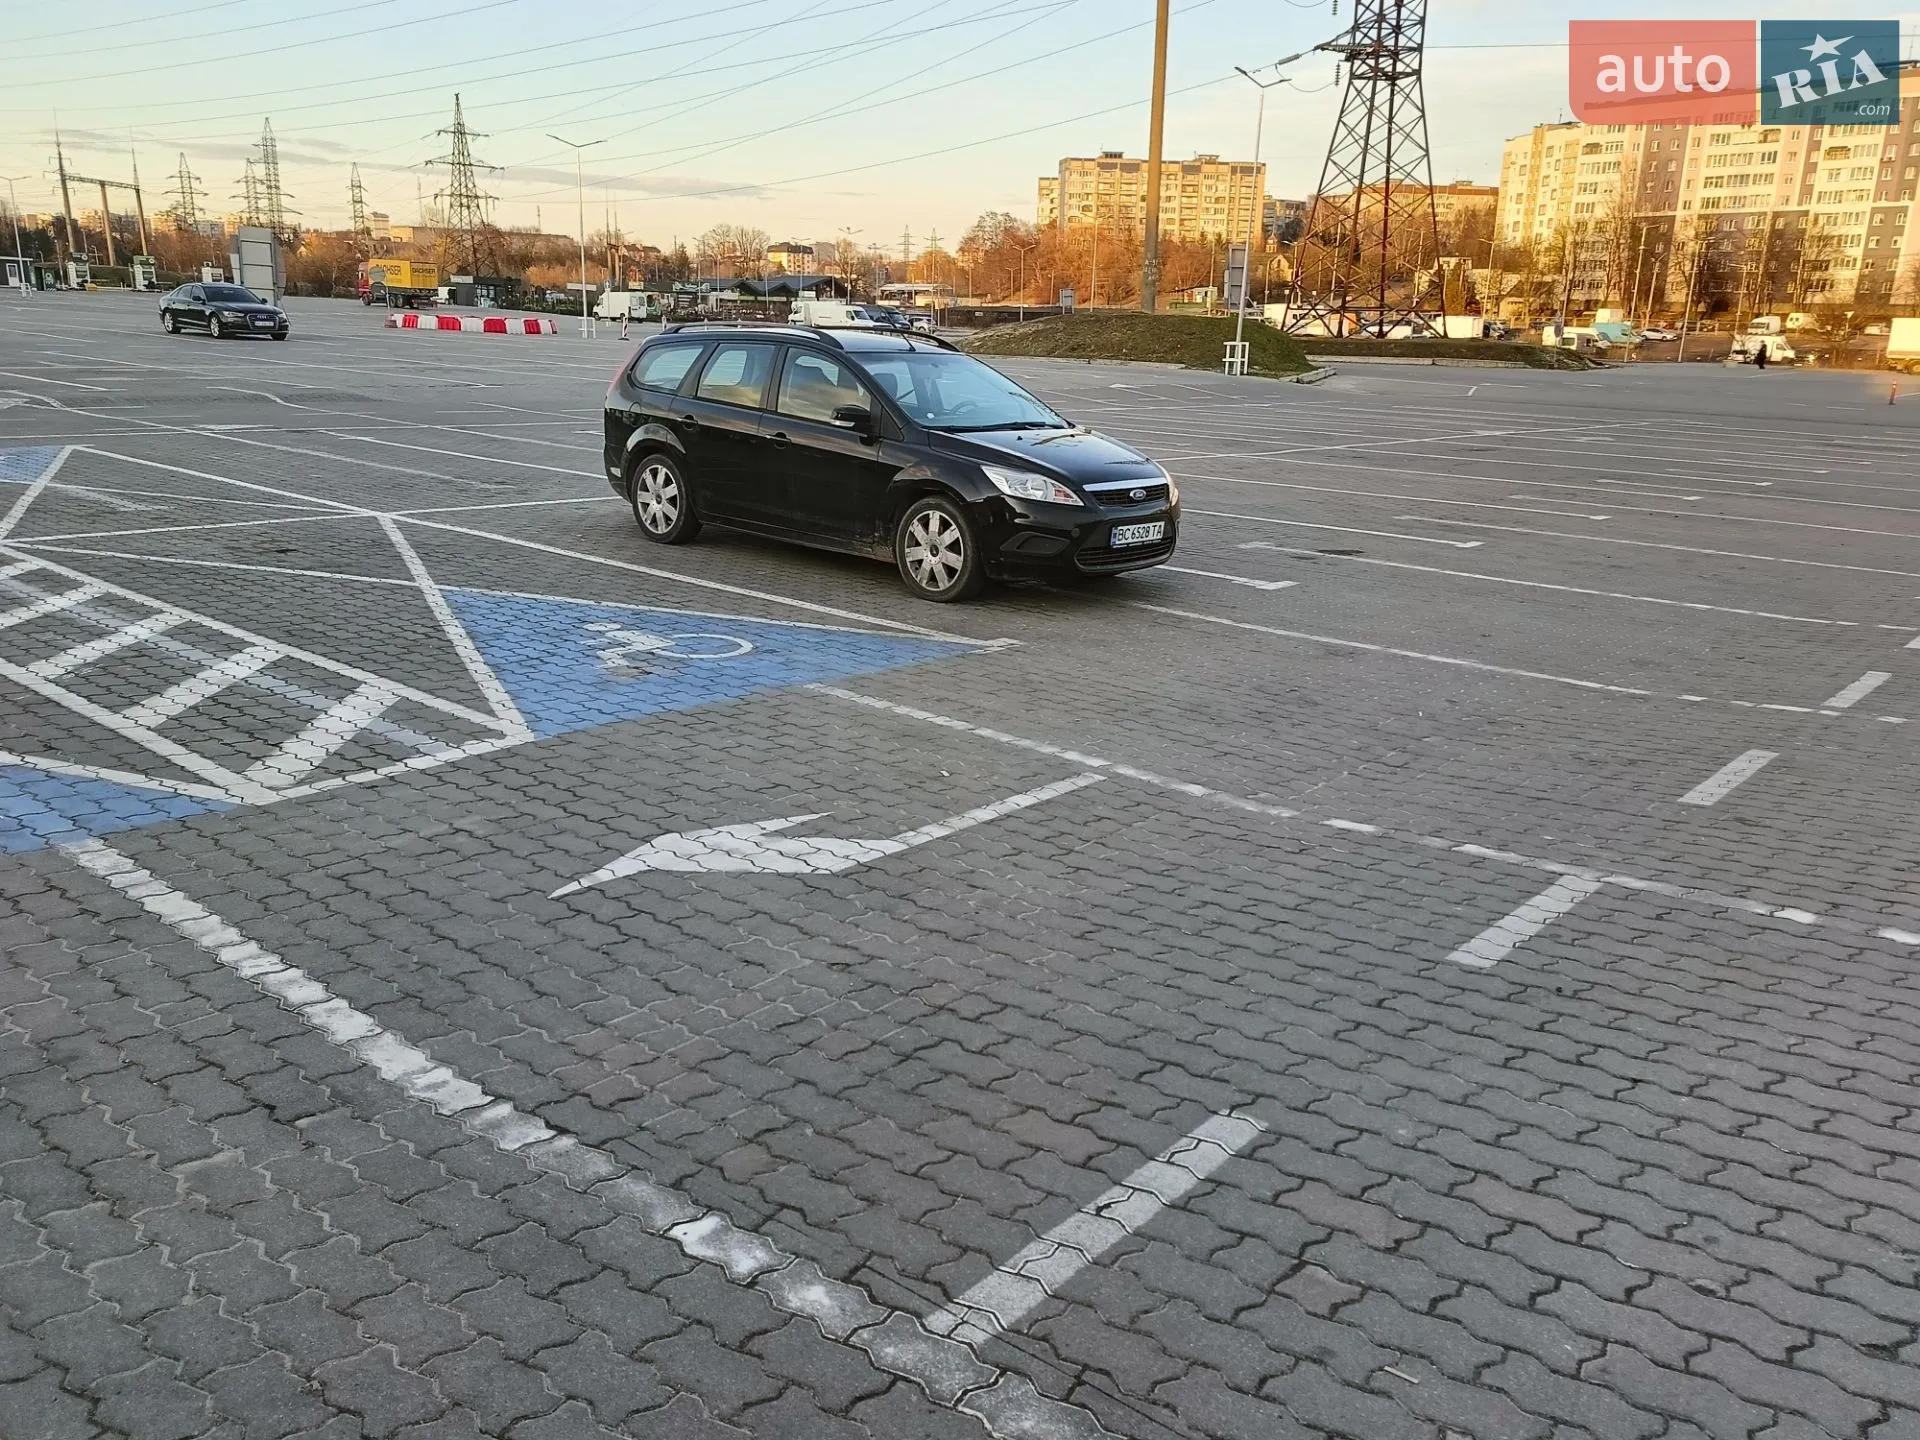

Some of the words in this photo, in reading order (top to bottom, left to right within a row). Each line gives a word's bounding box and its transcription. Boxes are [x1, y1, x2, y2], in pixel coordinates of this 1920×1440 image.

[1117, 528, 1130, 541] BC
[1131, 526, 1150, 540] 6528
[1151, 524, 1162, 537] TA
